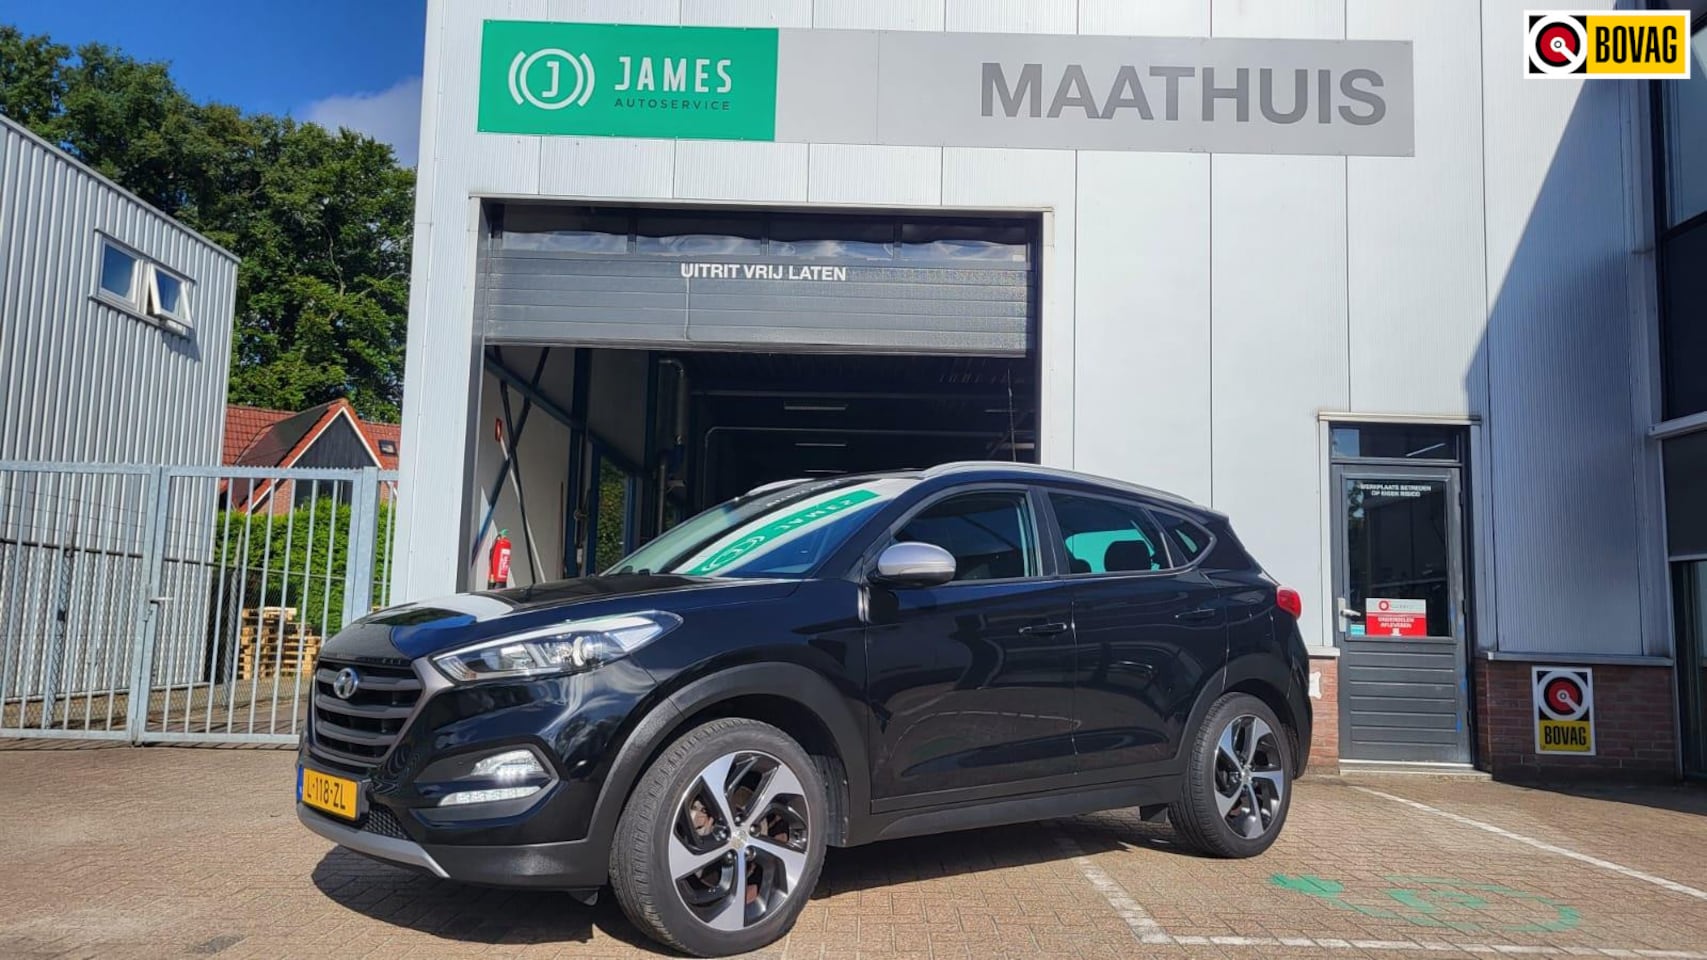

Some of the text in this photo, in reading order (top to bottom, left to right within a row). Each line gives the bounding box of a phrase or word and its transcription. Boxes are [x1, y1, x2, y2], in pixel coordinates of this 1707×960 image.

[614, 56, 732, 93] JAMES
[614, 98, 730, 111] AUTOSERVICE
[981, 62, 1387, 126] MAATHUIS
[680, 263, 846, 281] UITRIT VRIJ LATEN
[1544, 725, 1587, 746] BOVAG
